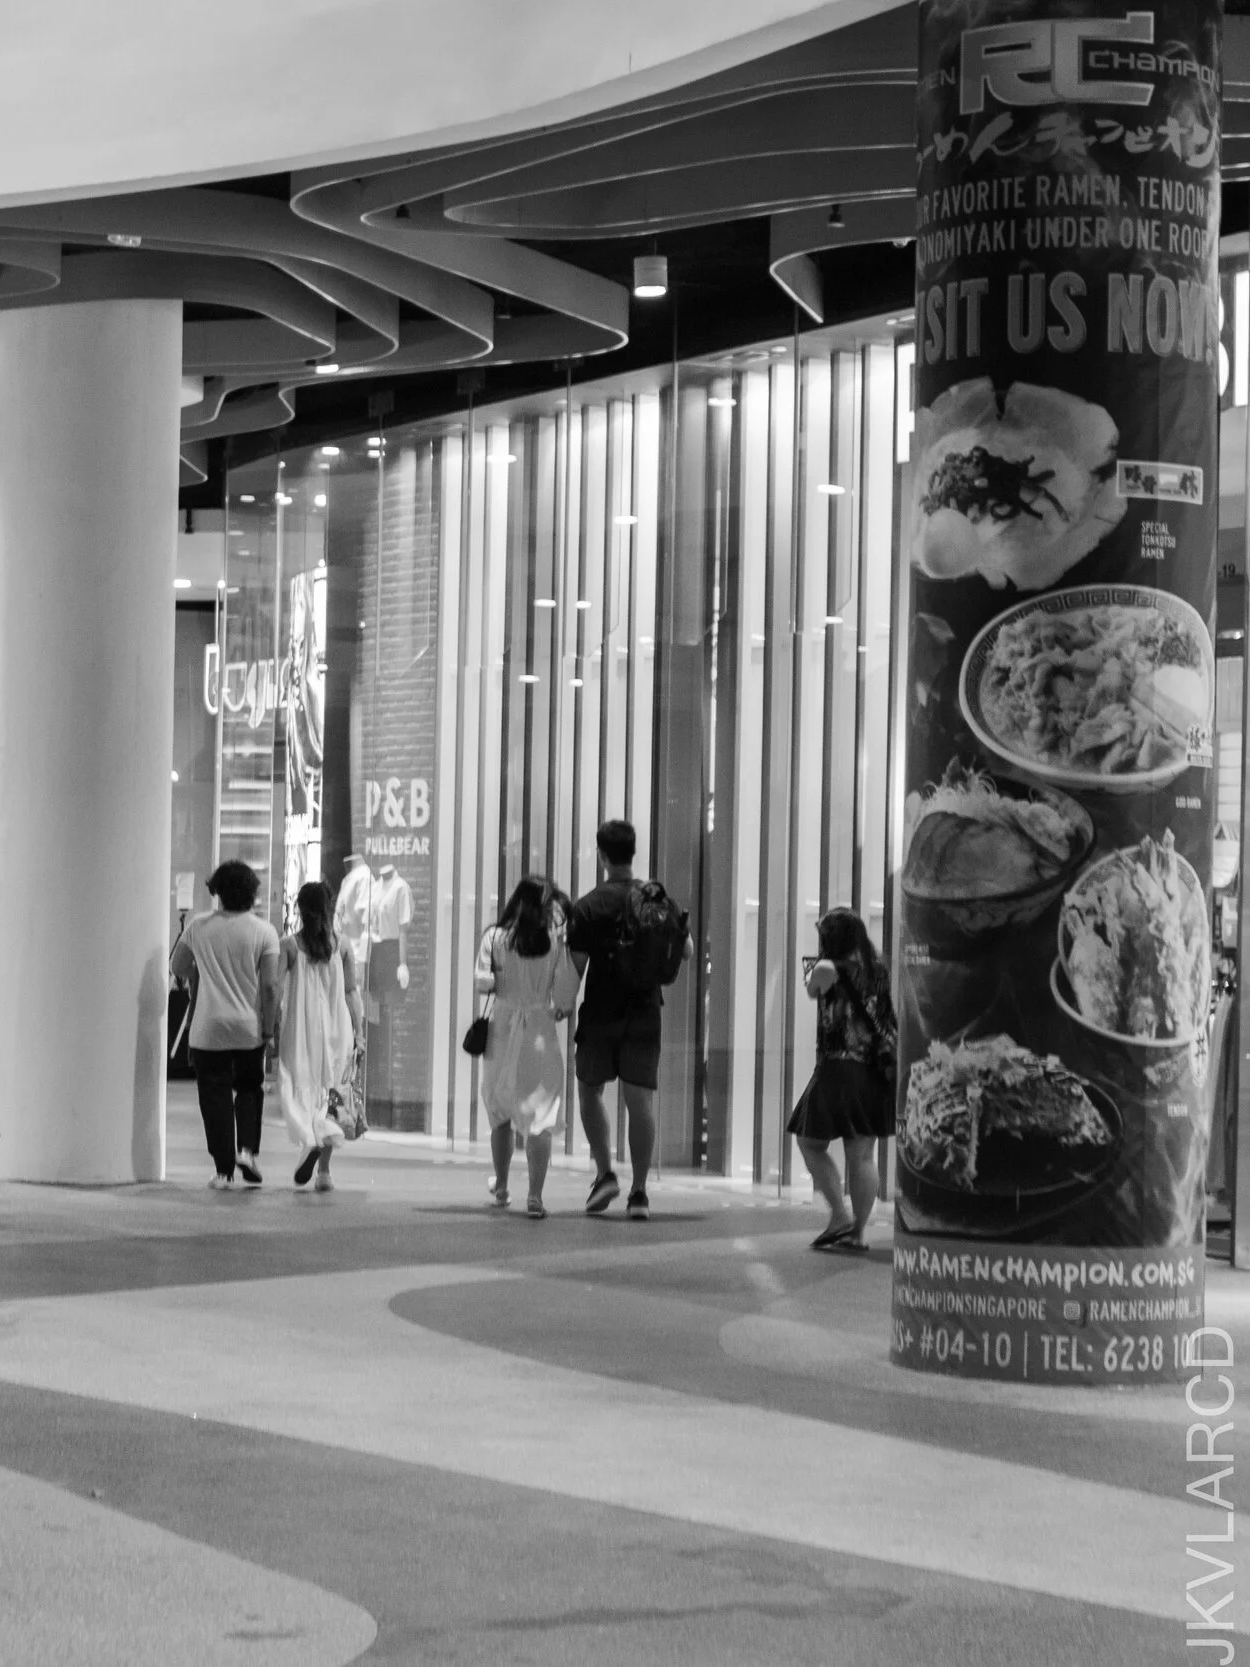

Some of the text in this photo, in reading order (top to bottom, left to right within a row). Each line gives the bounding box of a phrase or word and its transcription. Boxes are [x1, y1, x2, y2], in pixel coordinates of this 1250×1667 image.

[933, 176, 1026, 220] FAVORITE
[1027, 216, 1109, 249] UNDER
[1119, 217, 1162, 251] ONE
[1007, 271, 1087, 354] US
[1141, 520, 1169, 534] SPECIAL
[365, 776, 431, 829] P&B
[365, 834, 431, 856] PULL&BEAR
[919, 1323, 1011, 1367] #04-10
[1040, 1333, 1093, 1372] TEL:
[1103, 1334, 1164, 1372] 6238
